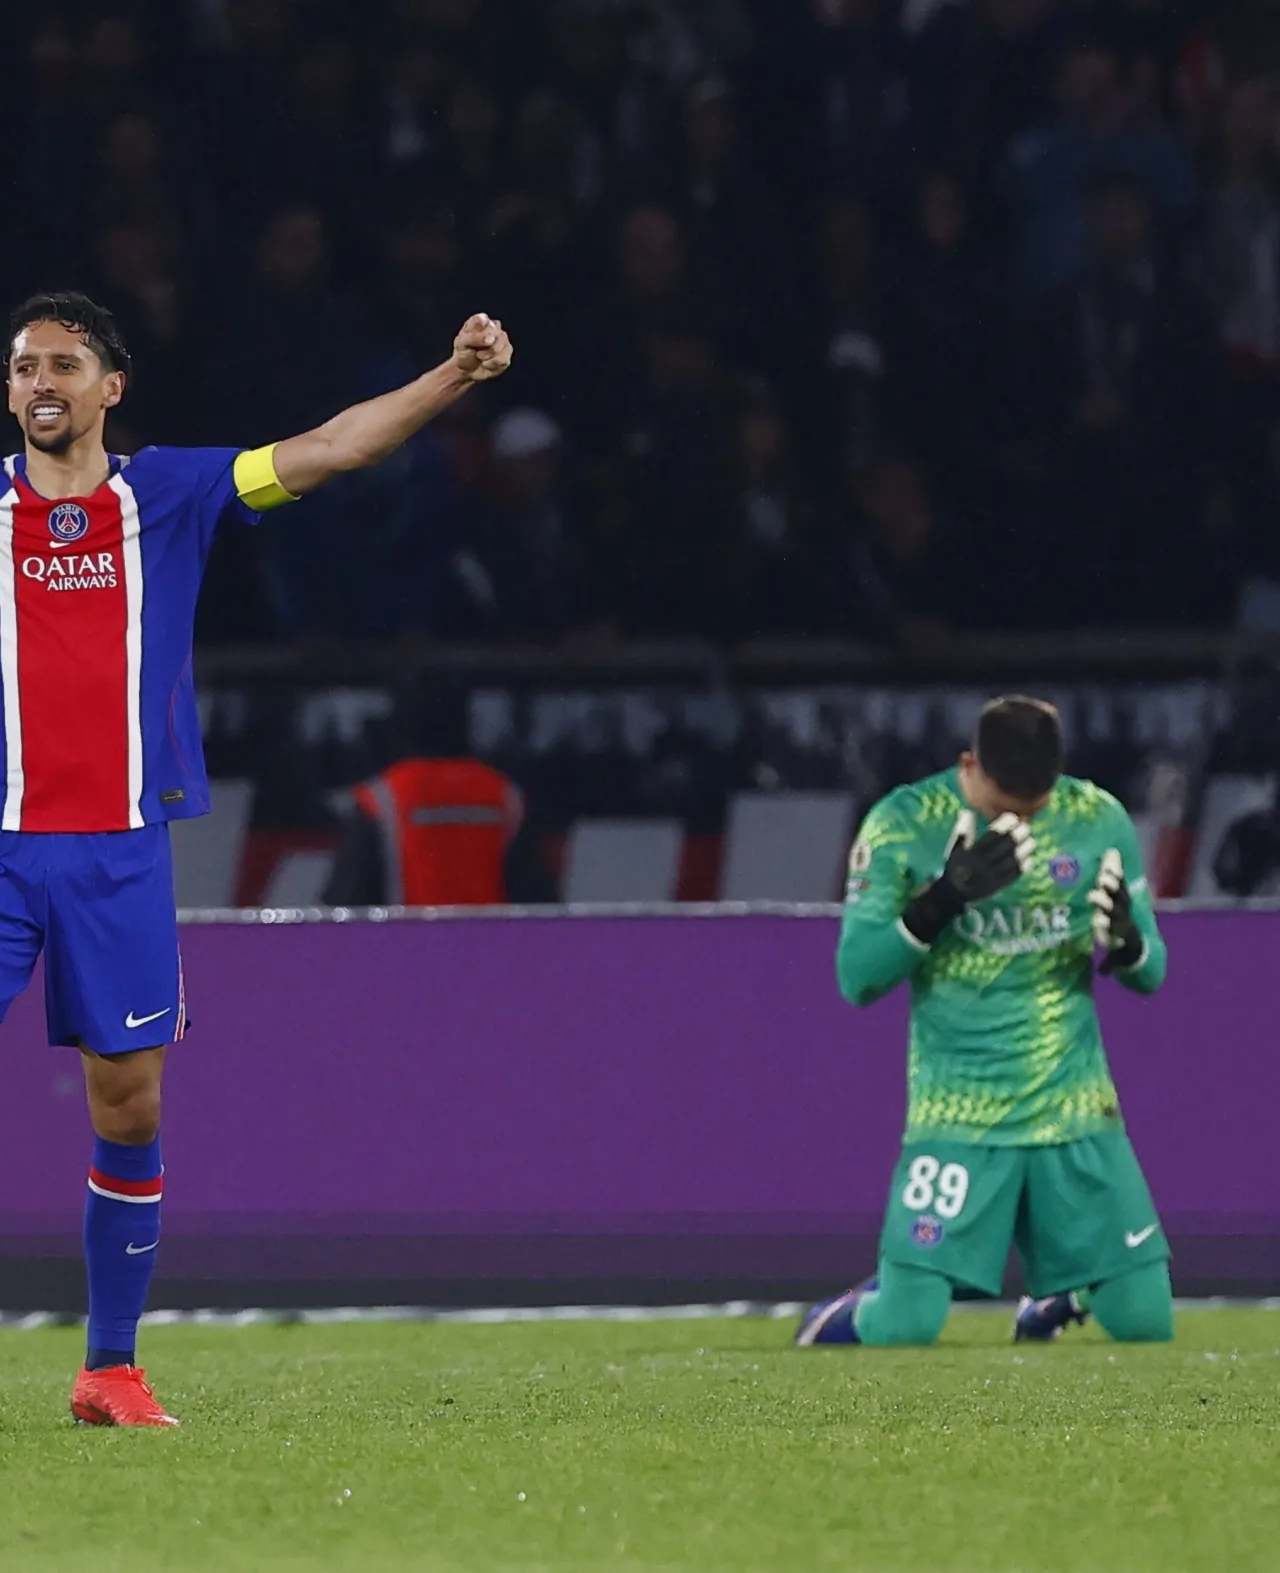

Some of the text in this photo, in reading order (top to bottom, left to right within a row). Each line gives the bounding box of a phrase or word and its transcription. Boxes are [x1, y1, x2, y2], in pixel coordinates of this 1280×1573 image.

[22, 552, 116, 581] QATAR
[47, 574, 117, 591] AIRWAYS
[902, 1155, 969, 1218] 89
